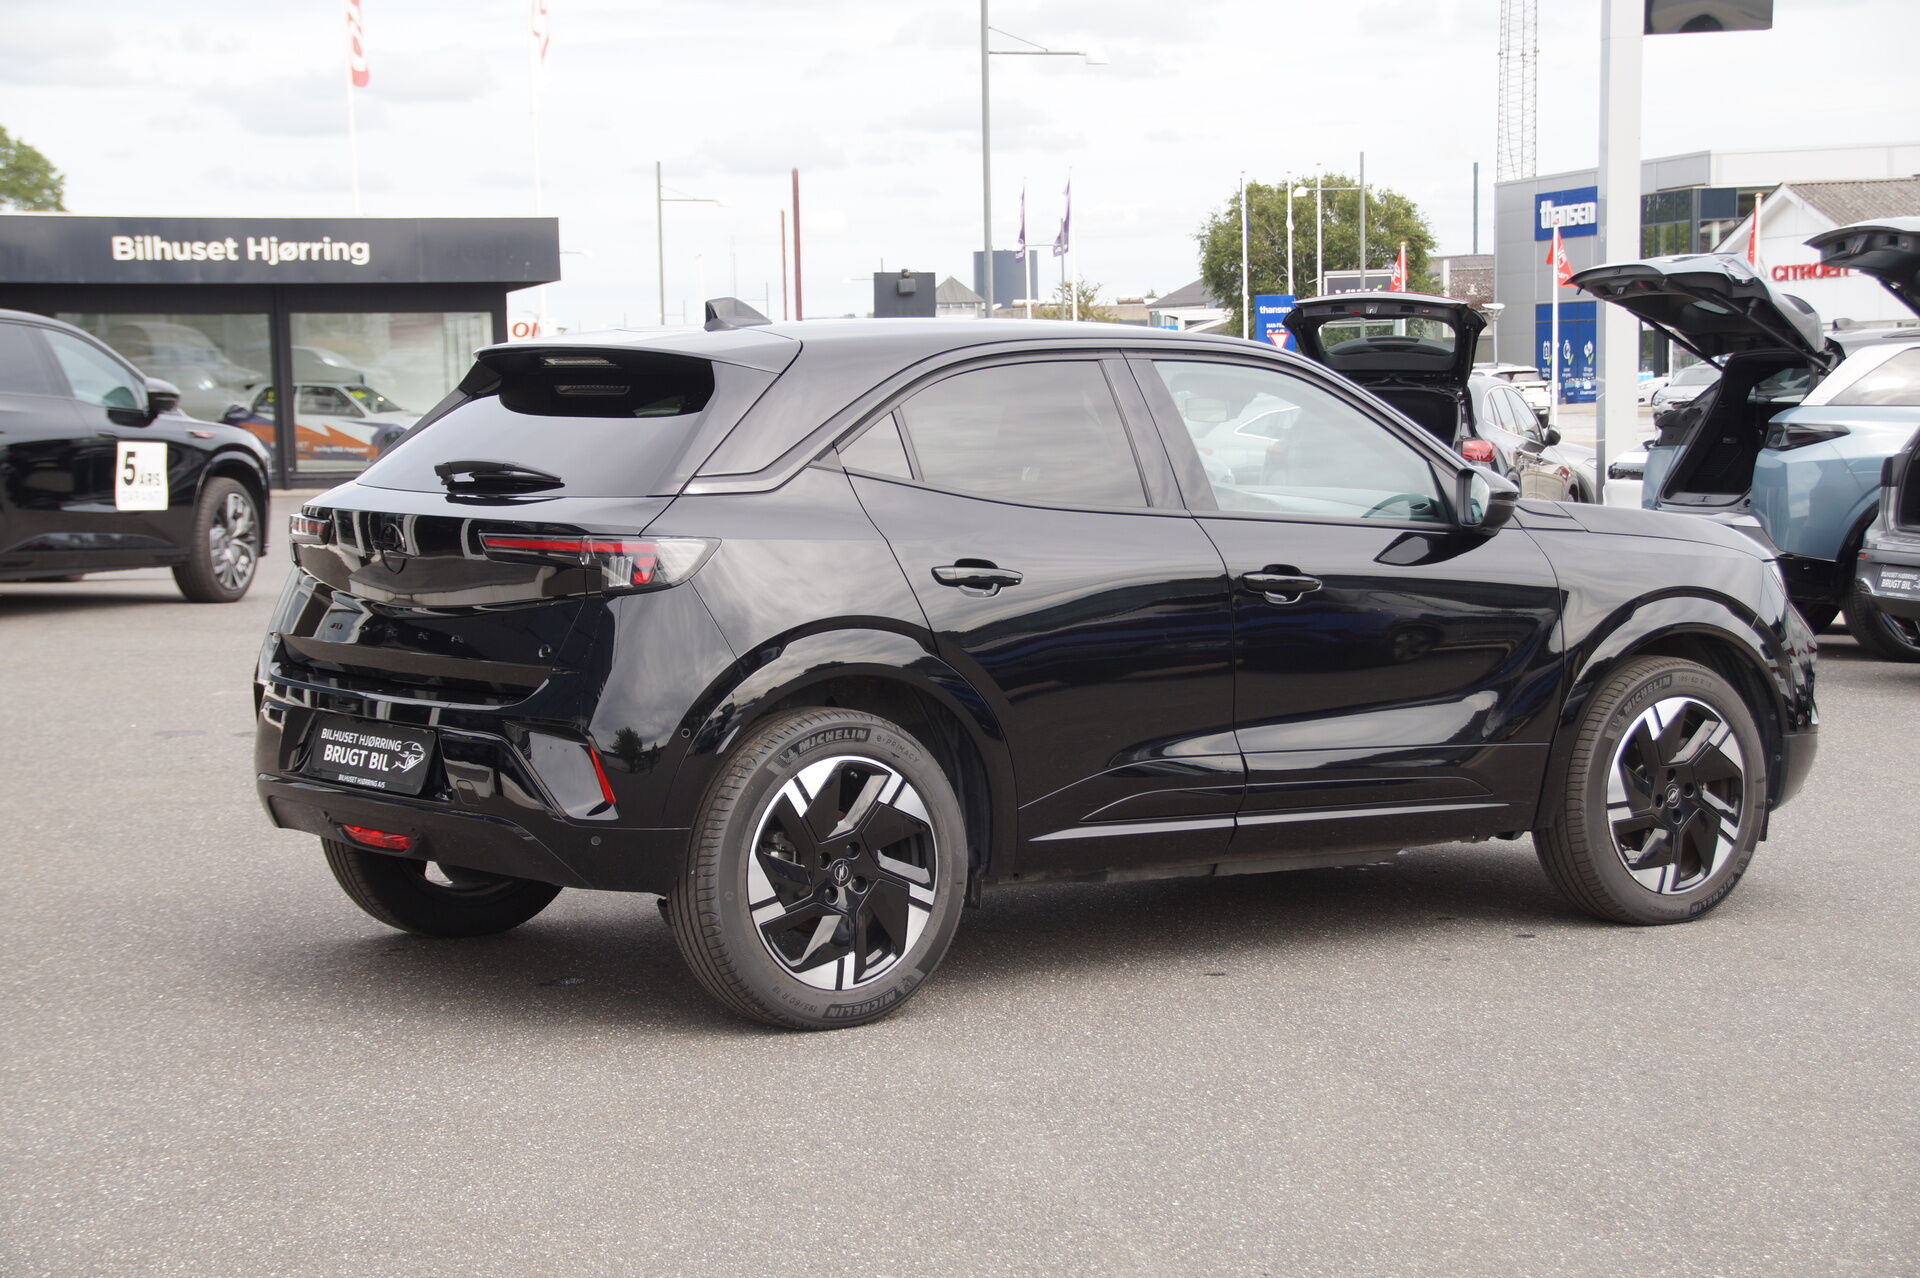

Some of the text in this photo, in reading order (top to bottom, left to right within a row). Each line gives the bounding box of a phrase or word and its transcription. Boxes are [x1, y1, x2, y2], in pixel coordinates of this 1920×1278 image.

[111, 235, 370, 265] Bilhuset Hjørring
[122, 450, 137, 487] 5
[321, 728, 402, 751] BILHUSET HJØRRING
[799, 729, 867, 752] MICHELIN
[323, 744, 389, 771] BRUGT BIL
[828, 990, 896, 1016] MICHELIN
